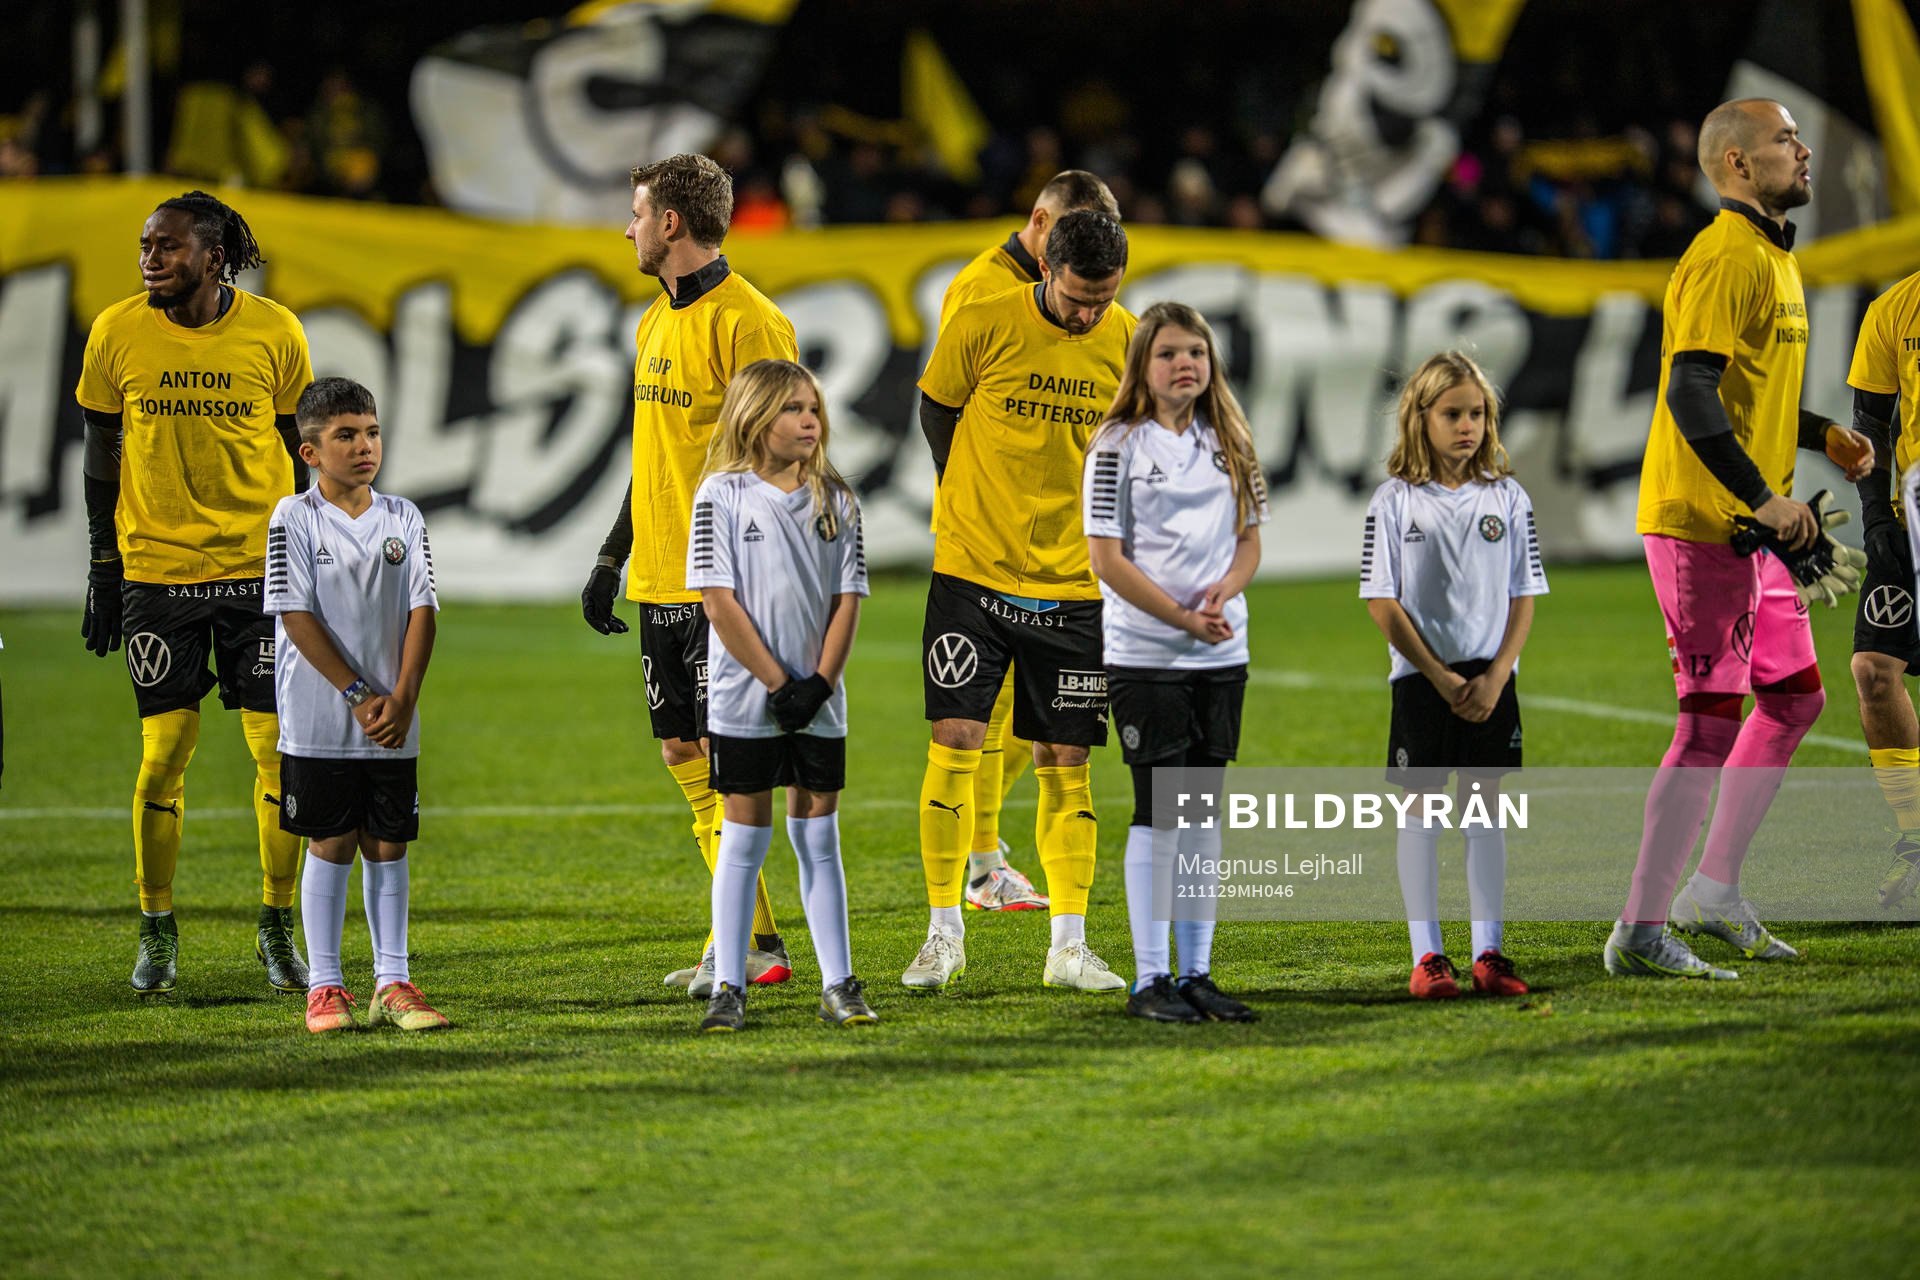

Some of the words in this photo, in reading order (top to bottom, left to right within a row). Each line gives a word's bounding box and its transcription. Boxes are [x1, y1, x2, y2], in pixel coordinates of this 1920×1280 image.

[159, 371, 231, 389] ANTON
[1029, 373, 1097, 399] DANIEL
[139, 398, 253, 417] JOHANSSON
[980, 596, 1067, 627] SÄLJFAST
[1689, 654, 1712, 677] 13
[1058, 674, 1108, 691] LB-HUS
[1051, 696, 1091, 711] Optimal
